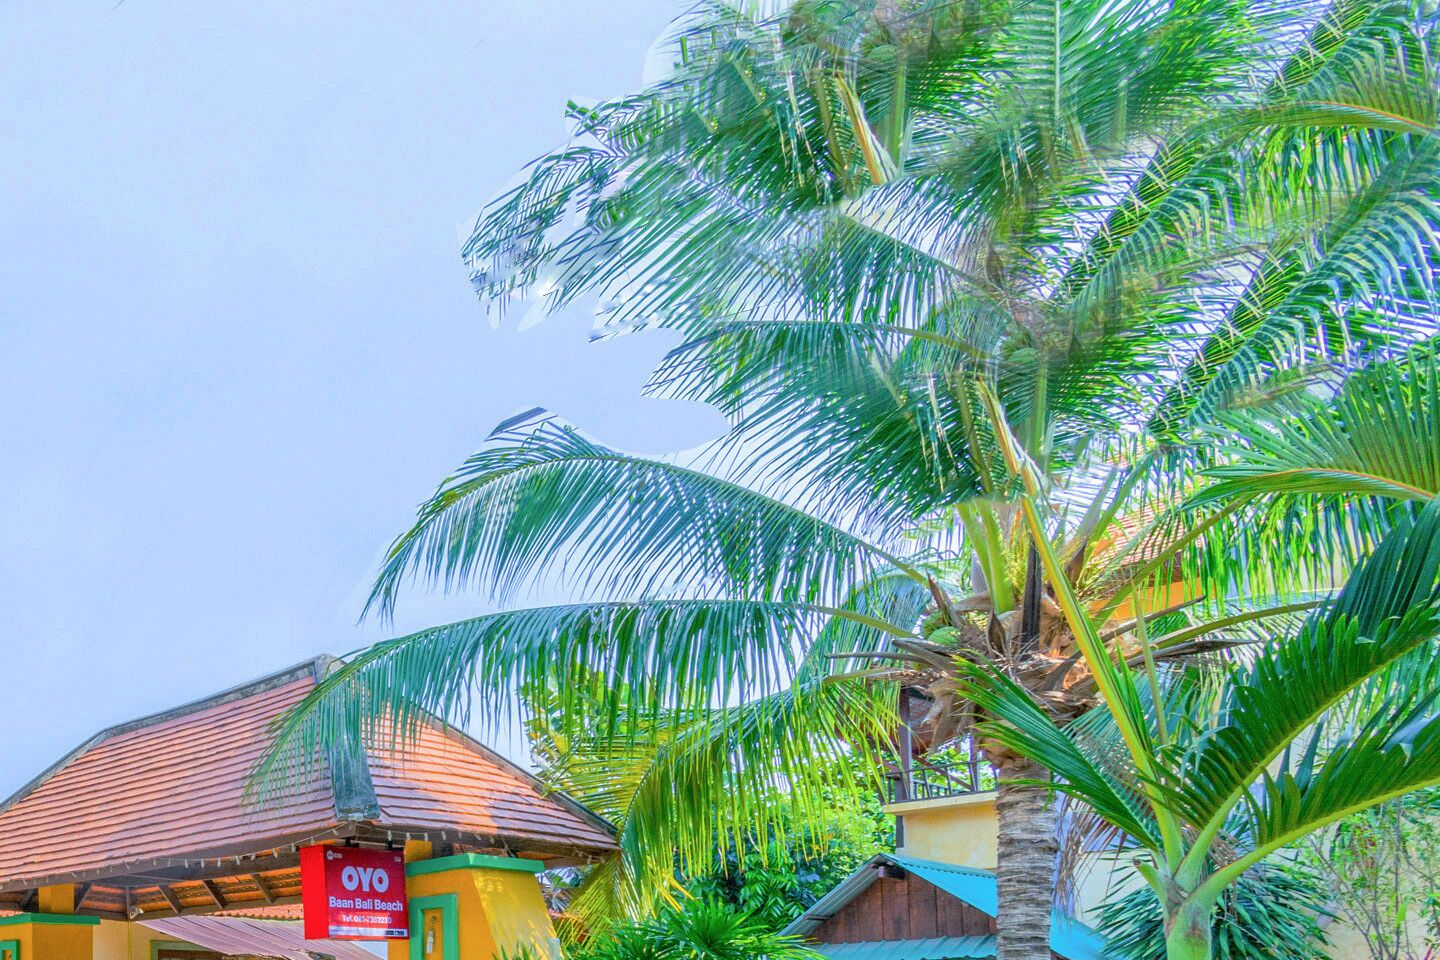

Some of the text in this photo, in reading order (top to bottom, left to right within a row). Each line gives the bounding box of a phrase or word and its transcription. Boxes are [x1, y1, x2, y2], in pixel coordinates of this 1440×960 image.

[342, 866, 389, 892] OYO
[329, 897, 403, 912] Baan Bali Beach
